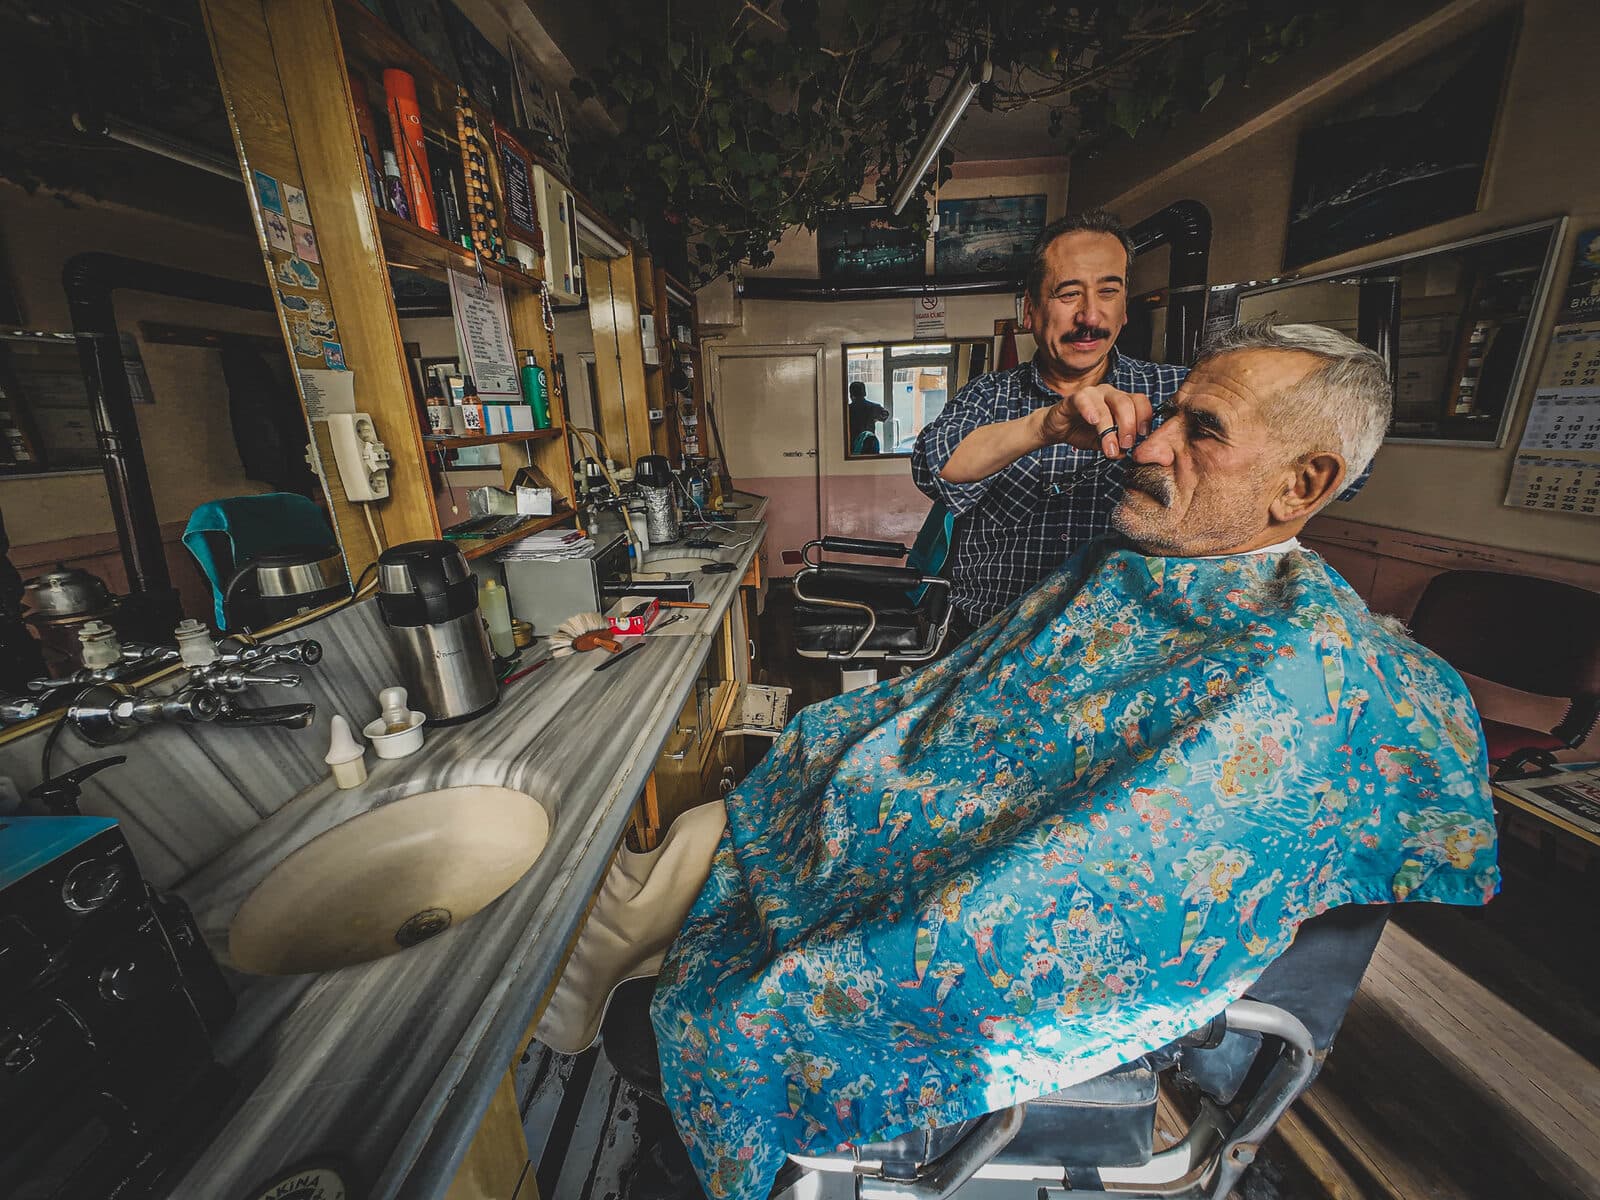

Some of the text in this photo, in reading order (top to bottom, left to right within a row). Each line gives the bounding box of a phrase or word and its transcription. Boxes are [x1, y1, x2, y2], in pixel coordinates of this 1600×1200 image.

[1575, 351, 1583, 359] 2
[1587, 359, 1600, 367] 10
[1585, 368, 1598, 376] 17
[1581, 377, 1595, 385] 24
[1557, 415, 1565, 423] 2
[1545, 432, 1558, 440] 16
[1565, 432, 1577, 440] 17
[1574, 478, 1581, 486] 8
[1566, 486, 1579, 494] 15
[1586, 488, 1599, 496] 16
[1561, 503, 1574, 511] 29
[1581, 505, 1594, 513] 30
